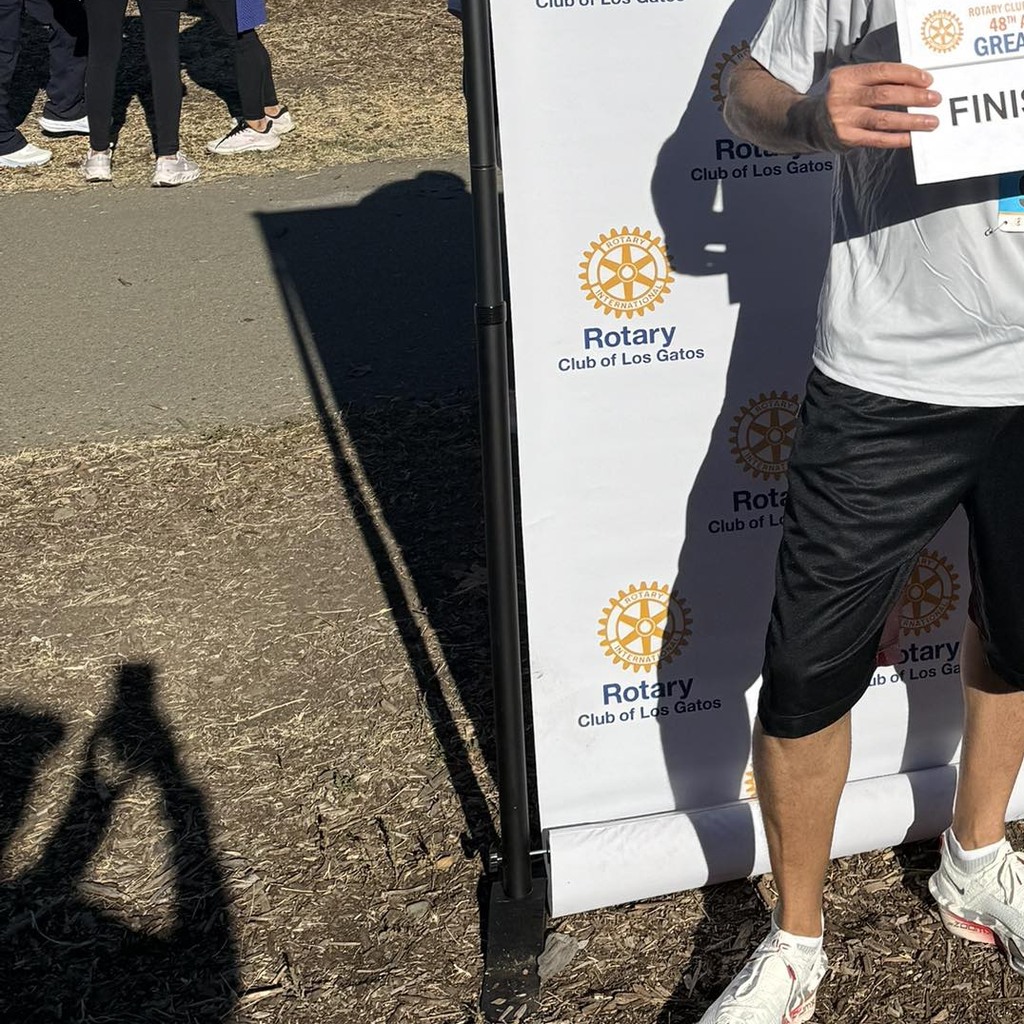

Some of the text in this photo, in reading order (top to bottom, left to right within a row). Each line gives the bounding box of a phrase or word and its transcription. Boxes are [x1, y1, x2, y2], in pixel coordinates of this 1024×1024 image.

[968, 4, 1002, 17] ROTARY
[989, 15, 1017, 32] 48TH
[691, 161, 833, 181] Club of Los Gatos
[606, 236, 646, 248] ROTARY
[595, 284, 662, 309] INTERNATIONAL
[584, 326, 676, 350] Rotary
[558, 348, 705, 371] Club of Los Gatos
[755, 400, 793, 413] ROTARY
[708, 518, 745, 534] Club
[749, 515, 765, 530] of
[624, 591, 664, 604] ROTARY
[614, 637, 679, 663] INTERNATIONAL
[900, 641, 960, 664] otary
[890, 670, 906, 683] of
[910, 668, 936, 680] Los
[602, 678, 694, 705] Rotary
[578, 699, 722, 727] Club of Los Gatos
